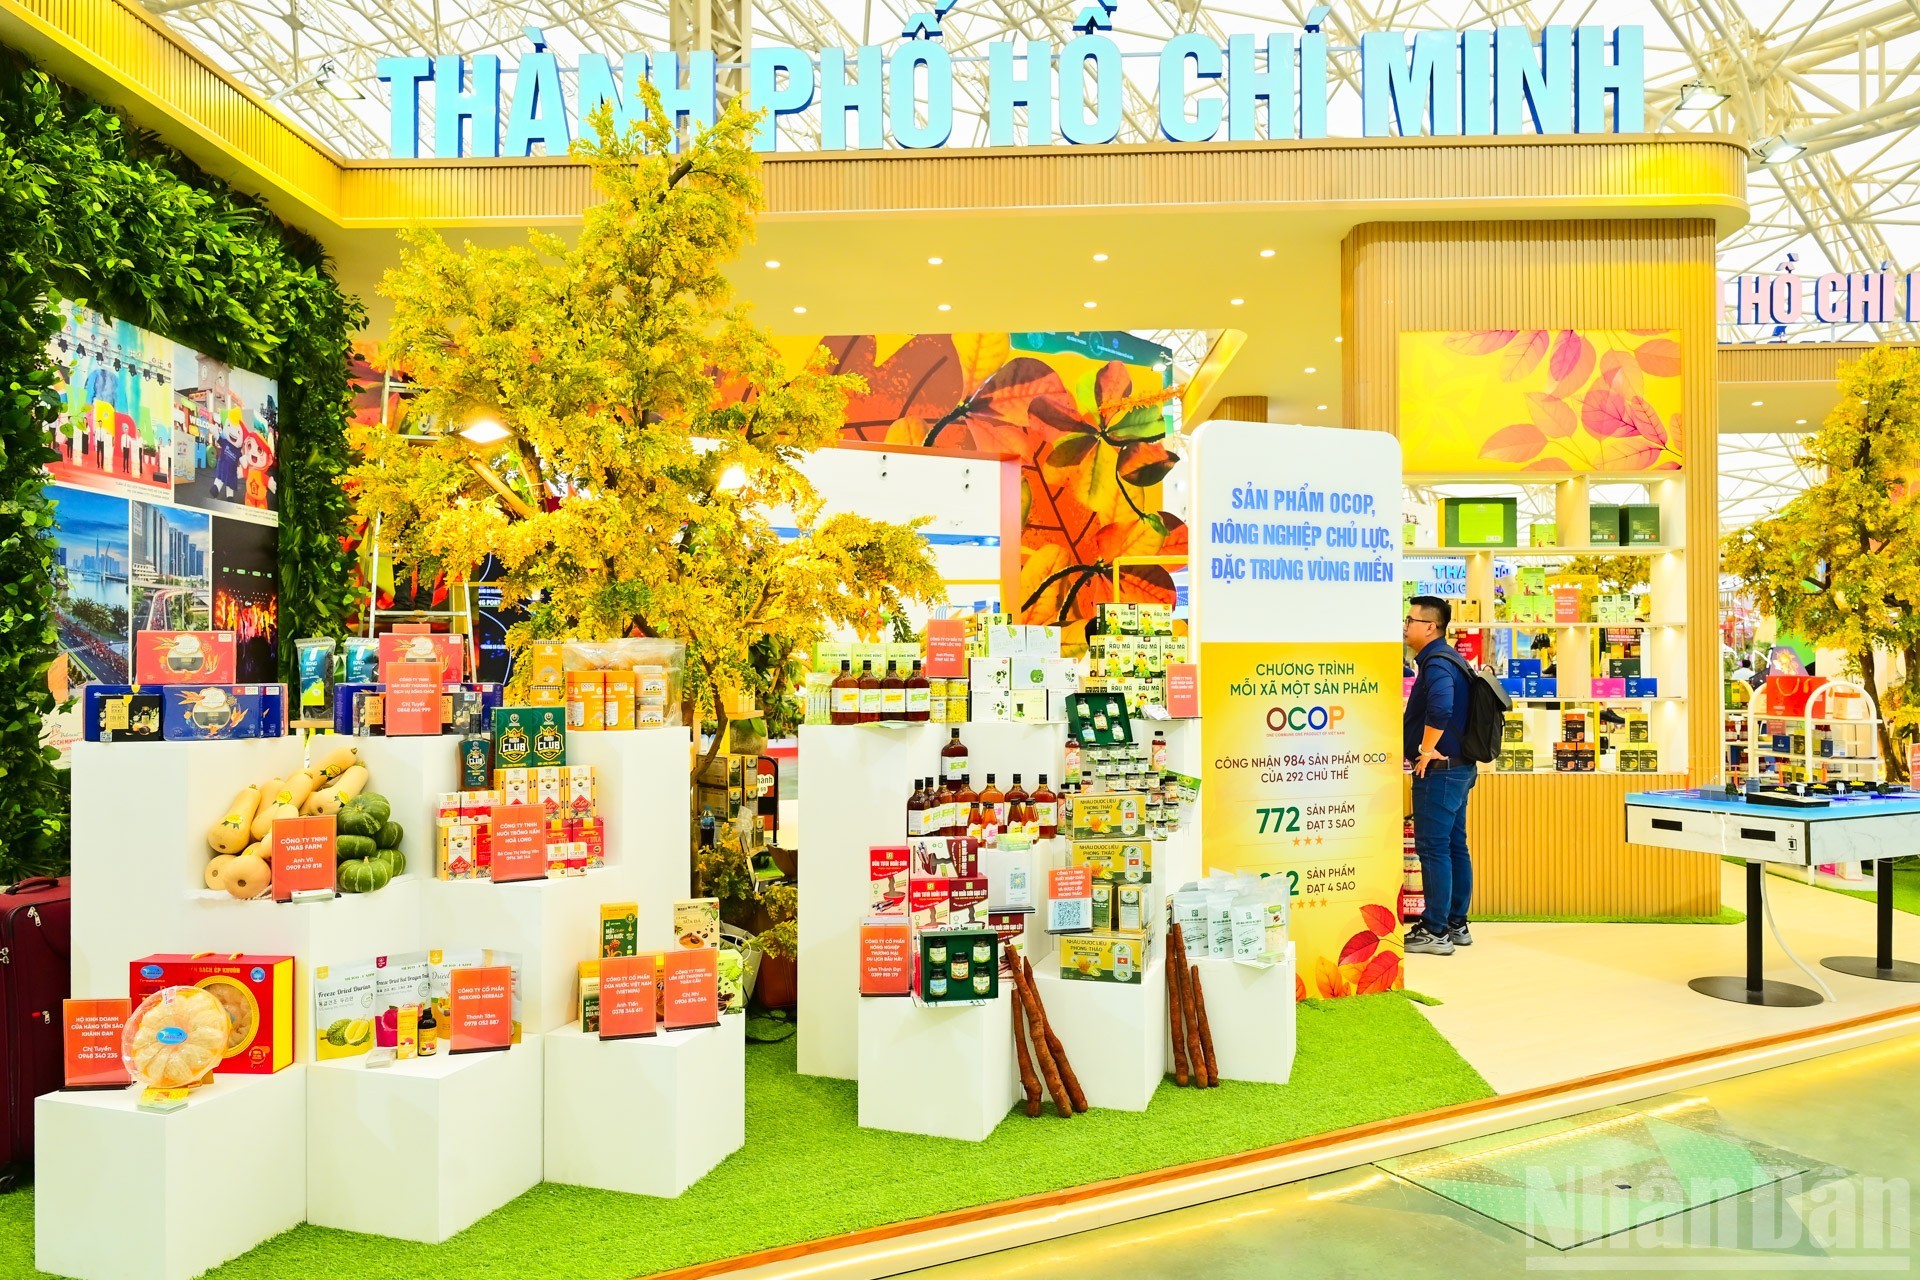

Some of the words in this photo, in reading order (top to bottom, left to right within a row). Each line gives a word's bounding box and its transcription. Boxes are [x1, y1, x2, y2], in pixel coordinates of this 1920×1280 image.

[378, 26, 716, 158] THÀNH
[750, 0, 955, 153] PHỐ
[1158, 6, 1330, 142] CHÍ
[1361, 25, 1644, 138] MINH
[1737, 253, 1802, 325] HỒ
[1815, 260, 1896, 324] CHÍ
[1232, 482, 1268, 510] SẢN
[1274, 483, 1324, 512] PHẨM
[1330, 492, 1376, 518] OCOP,
[1212, 518, 1258, 544] NÔNG
[1263, 522, 1322, 550] NGHIỆP
[1326, 521, 1358, 548] CHỦ
[1362, 526, 1394, 552] LỰC,
[1212, 554, 1246, 584] ĐẶC
[1250, 557, 1304, 580] TRƯNG
[1308, 556, 1350, 582] VÙNG
[1354, 556, 1394, 582] MIỀN
[1256, 662, 1314, 676] CHƯƠNG
[1318, 660, 1354, 675] TRÌNH
[1230, 678, 1256, 696] MỖI
[1260, 680, 1277, 696] XÃ
[1281, 680, 1310, 698] MỘT
[1314, 678, 1339, 694] SẢN
[1343, 677, 1378, 694] PHẨM
[1266, 706, 1344, 732] OCOP
[503, 743, 525, 752] CLUB
[538, 741, 560, 750] CLUB
[1215, 757, 1248, 769] CÔNG
[1252, 754, 1281, 771] NHẬN
[1284, 754, 1305, 767] 984
[1308, 752, 1328, 765] SẢN
[1332, 750, 1360, 765] PHẨM
[1363, 752, 1392, 763] OCOP
[1261, 769, 1283, 783] CỦA
[1286, 772, 1303, 782] 292
[1306, 768, 1328, 781] CHỦ
[1331, 767, 1349, 780] THỂ
[1306, 804, 1326, 816] SẢN
[1328, 801, 1355, 814] PHẨM
[1256, 806, 1300, 834] 772
[1307, 820, 1324, 832] ĐẠT
[1328, 819, 1333, 828] 3
[1336, 818, 1356, 829] SAO
[1307, 867, 1326, 879] SẢN
[1328, 864, 1355, 877] PHẨM
[1307, 883, 1324, 896] ĐẠT
[1327, 882, 1333, 892] 4
[1336, 881, 1356, 892] SAO
